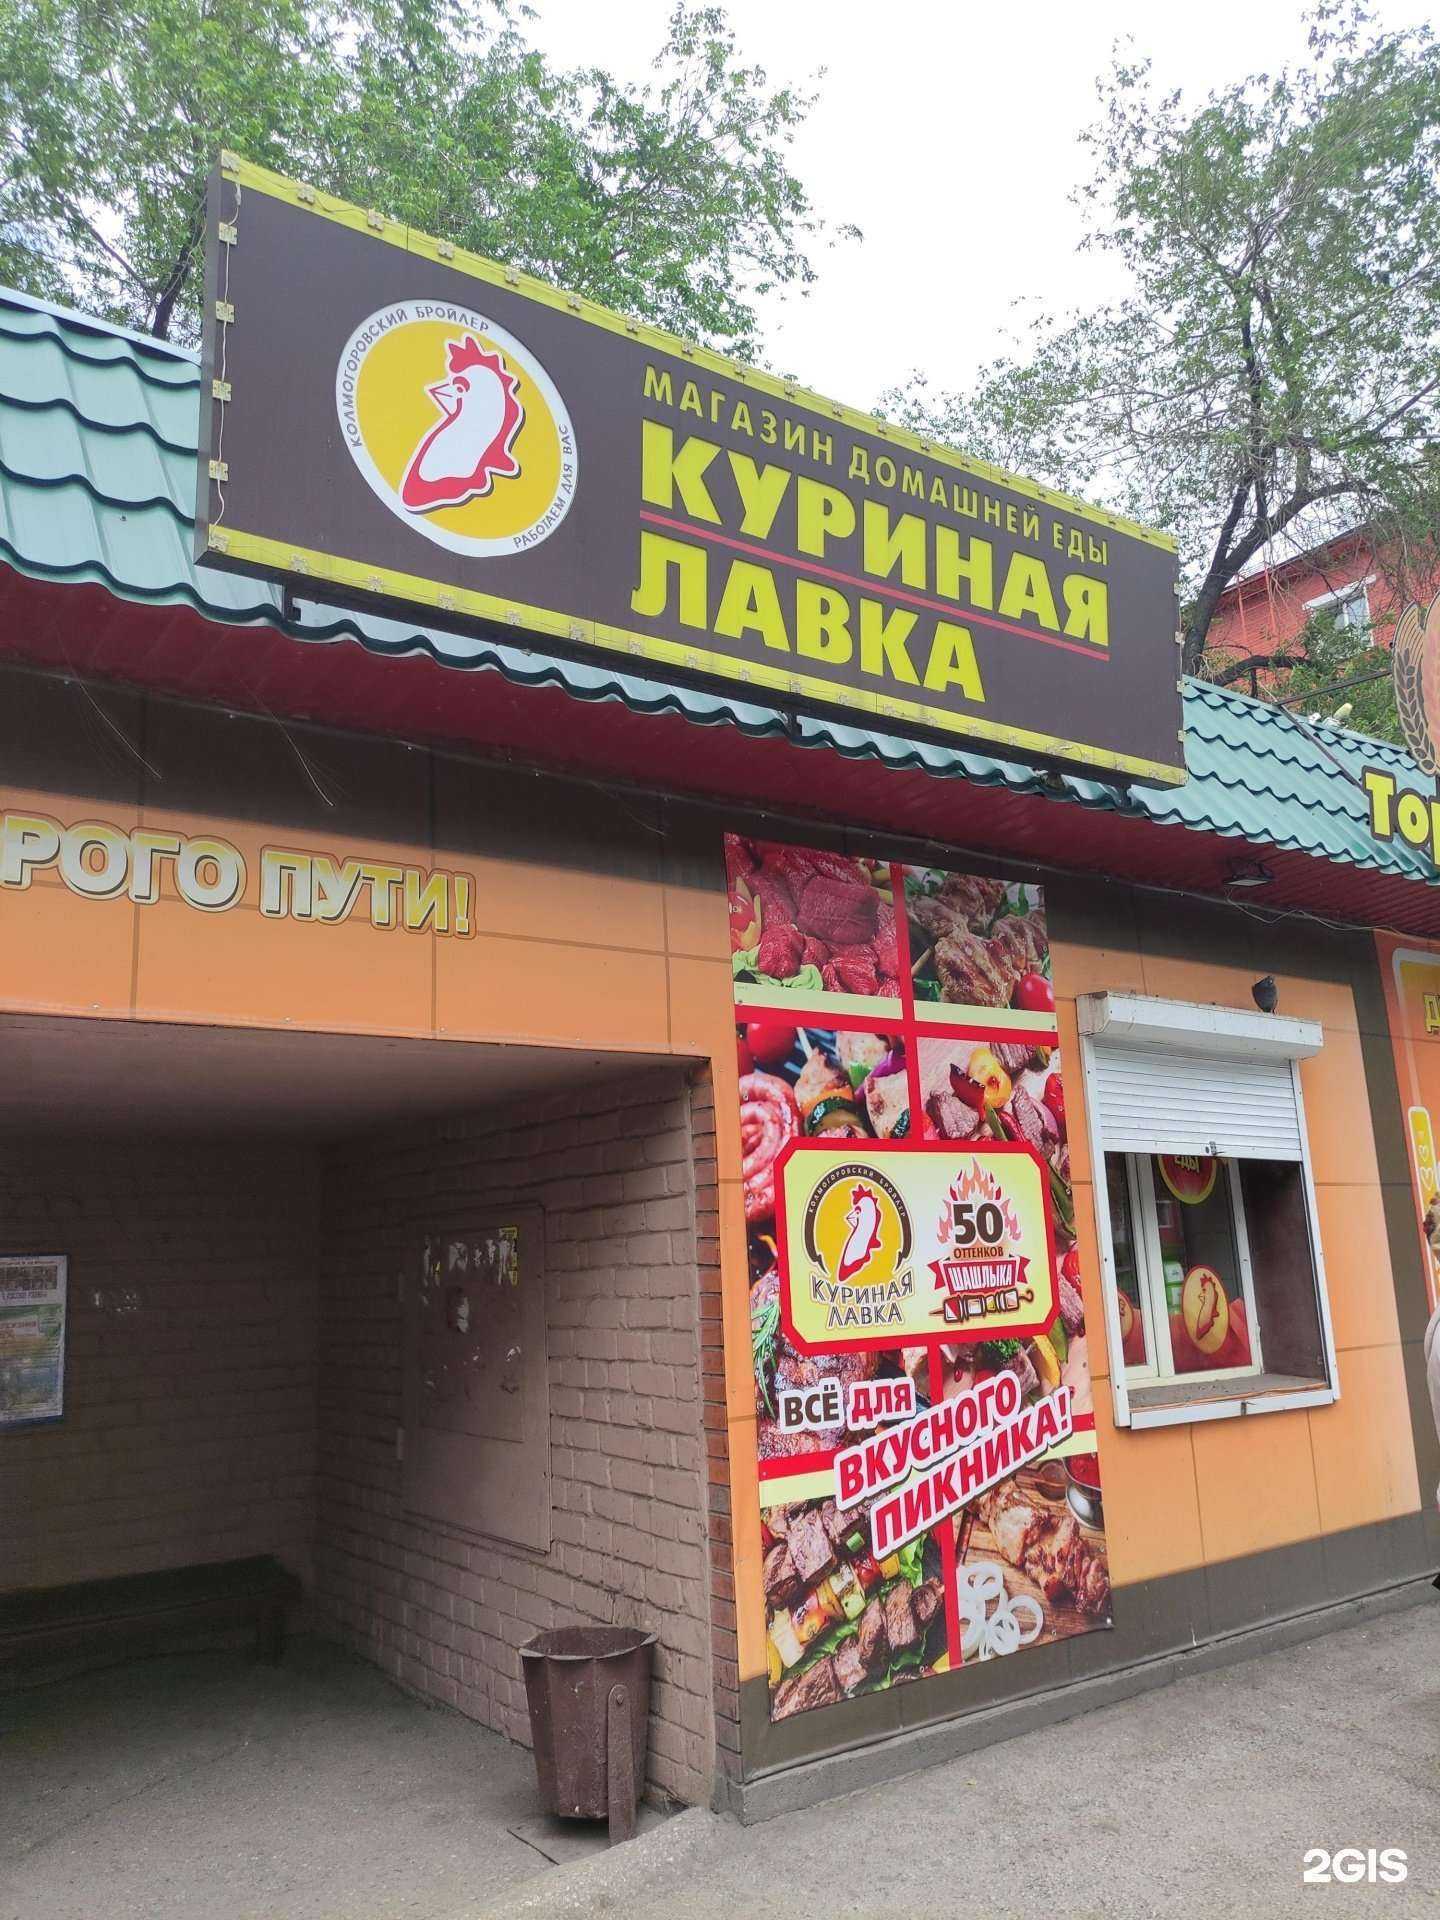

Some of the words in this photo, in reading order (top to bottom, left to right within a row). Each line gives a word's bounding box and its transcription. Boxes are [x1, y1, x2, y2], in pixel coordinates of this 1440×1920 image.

[342, 308, 409, 448] КОЛМОГОРОВСКИЙ
[415, 306, 490, 332] БРОЙЛЕР
[558, 423, 573, 455] ВАС
[560, 463, 573, 495] ДЛЯ
[643, 364, 834, 465] МАГАЗИН
[848, 446, 1040, 543] ДОМАШНЕЙ
[1053, 521, 1109, 566] ЕДЫ
[513, 496, 567, 548] РАБОТАЕМ
[641, 418, 1110, 648] КУРИНАЯ
[630, 530, 986, 703] ЛАВКА
[0, 814, 241, 909] РОГО
[261, 850, 471, 935] ПУТИ!
[808, 1167, 875, 1213] КОЛМОГОРОВСКИЙ
[879, 1178, 906, 1218] БРОЙЛЕР
[952, 1202, 1004, 1245] 50
[947, 1263, 1013, 1292] ШАШЛЫКА
[953, 1246, 1004, 1259] ОТТЕНКОВ
[811, 1270, 913, 1304] КУРИНАЯ
[828, 1302, 903, 1327] ЛАВКА
[784, 1383, 839, 1427] ВСЁ
[851, 1383, 912, 1424] ДЛЯ
[838, 1376, 1018, 1501] ВКУСНОГО
[874, 1393, 1068, 1552] ПИКНИКА!
